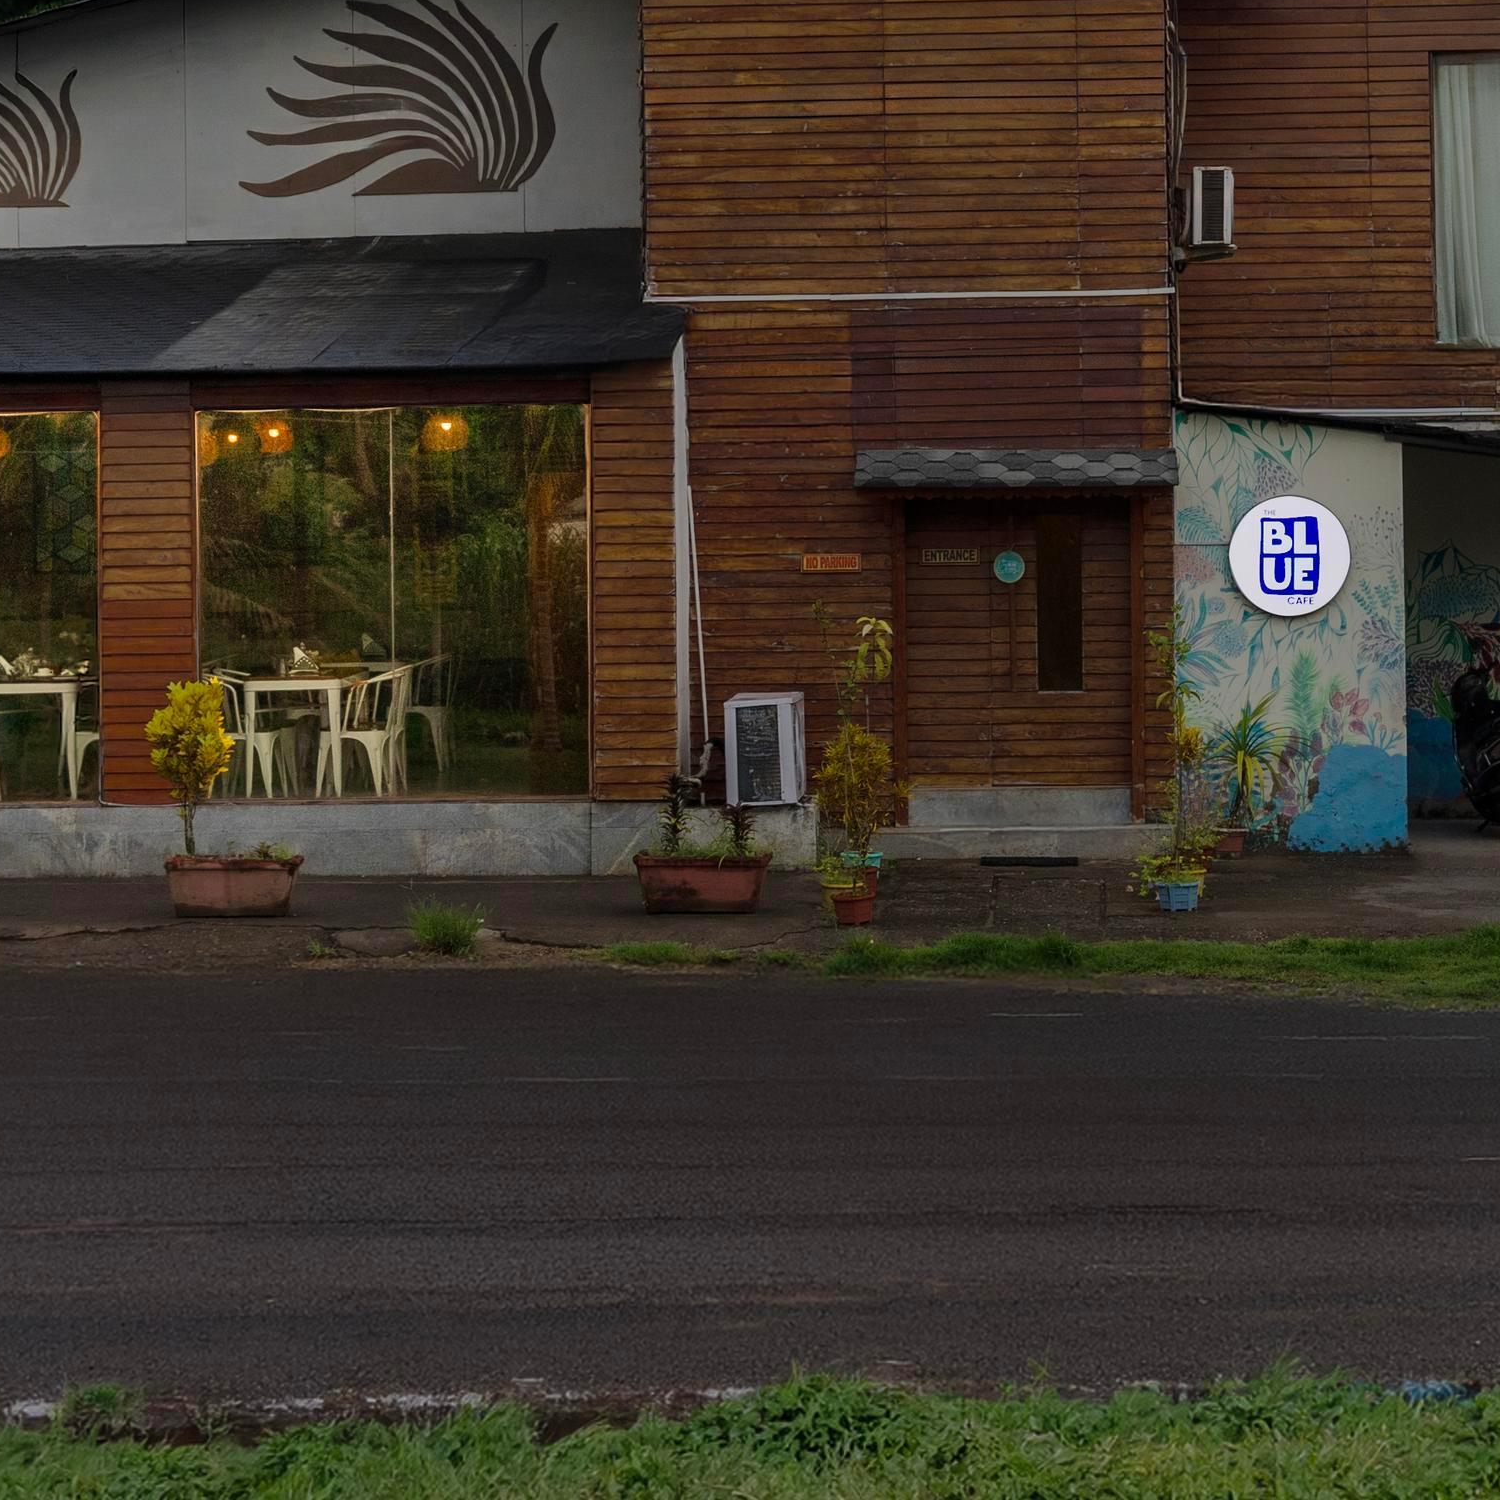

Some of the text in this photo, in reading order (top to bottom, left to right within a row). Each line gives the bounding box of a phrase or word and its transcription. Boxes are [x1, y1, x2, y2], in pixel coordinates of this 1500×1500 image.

[924, 549, 975, 562] ENTRANCE
[806, 556, 857, 569] NO PARKING
[1287, 596, 1314, 605] CAFE
